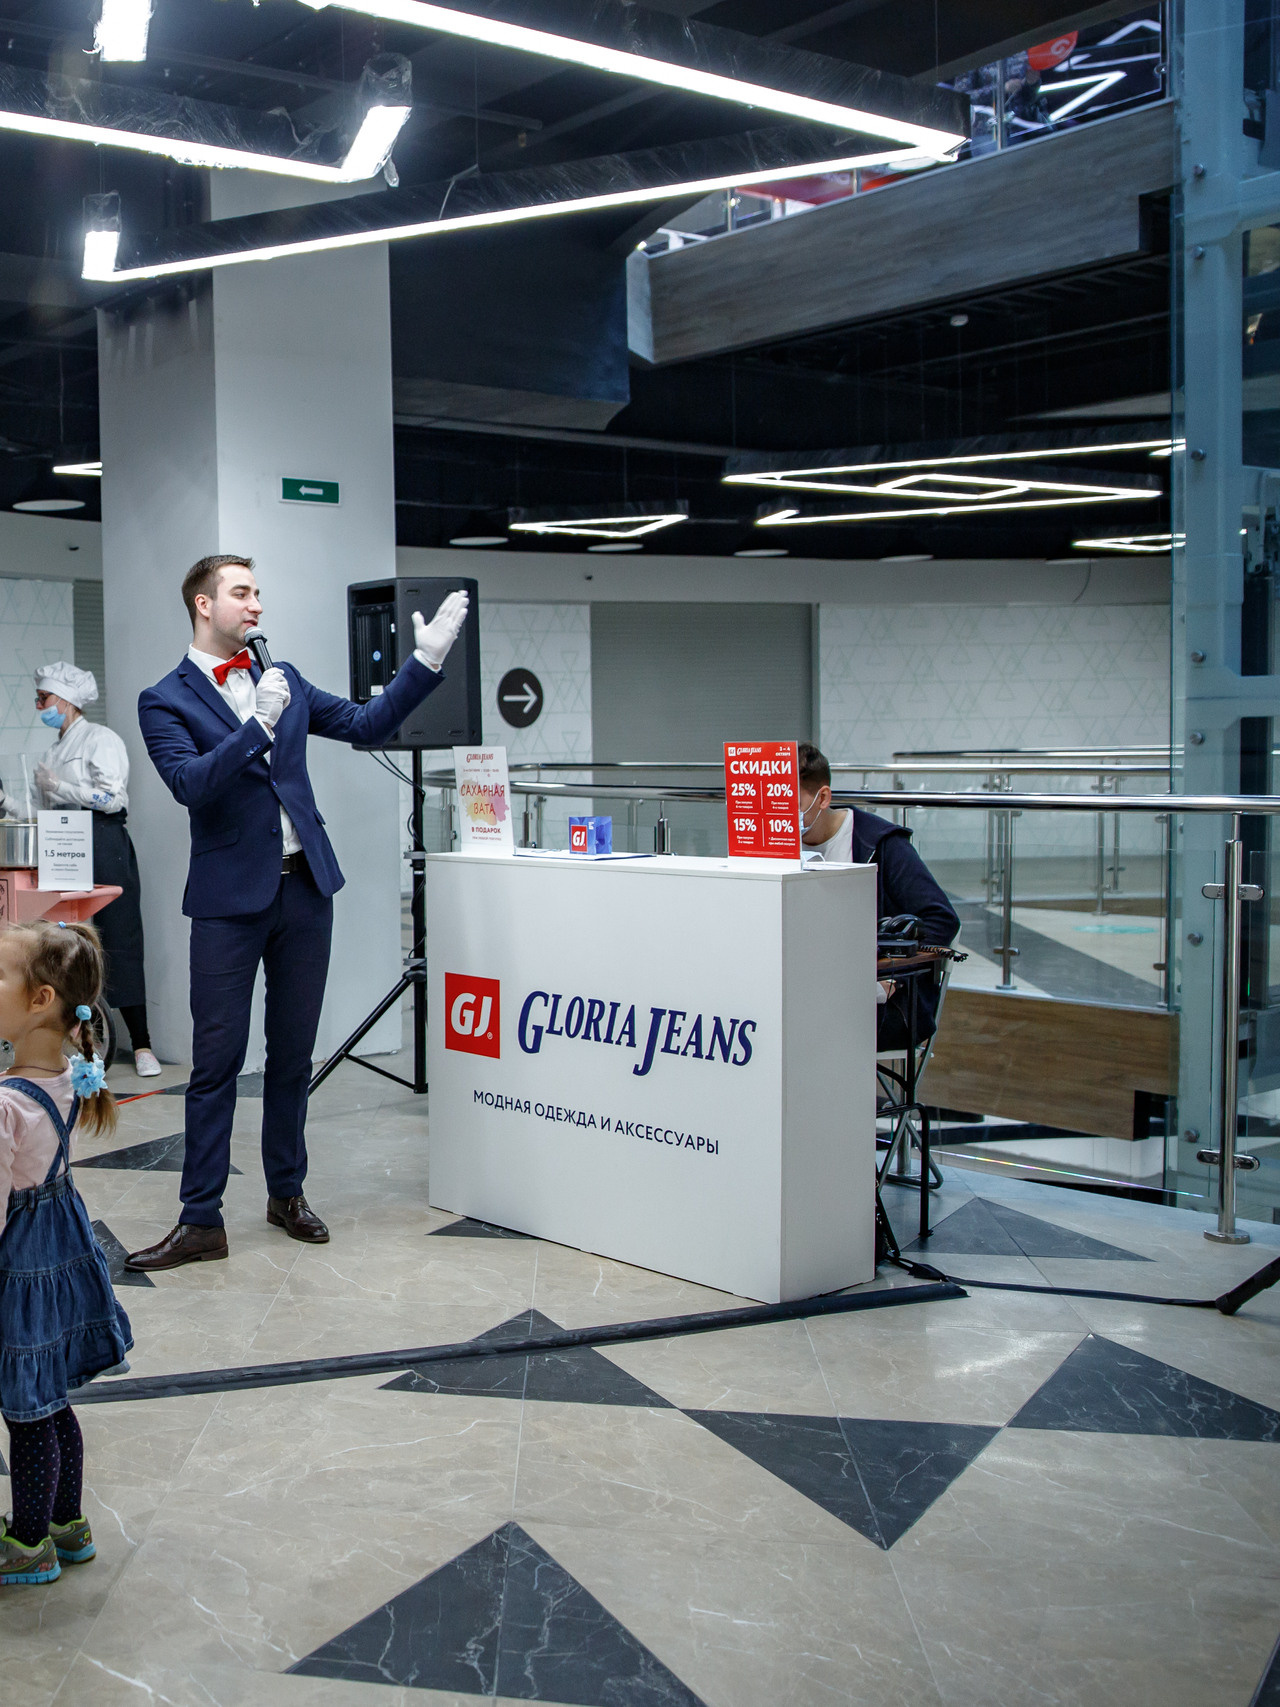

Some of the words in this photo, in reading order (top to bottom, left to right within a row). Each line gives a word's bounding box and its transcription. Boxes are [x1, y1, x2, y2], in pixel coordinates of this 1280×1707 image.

[730, 761, 792, 776] СКИДКИ
[460, 784, 505, 798] САХАРНАЯ
[731, 783, 757, 797] 25%
[766, 784, 794, 797] 20%
[473, 802, 496, 815] ВАТА
[733, 818, 757, 832] 15%
[768, 819, 794, 833] 10%
[57, 851, 86, 859] метров
[518, 990, 637, 1054] GLORIA
[632, 1007, 758, 1077] JEANS
[473, 1089, 531, 1115] МОДНАЯ
[534, 1102, 597, 1129] ОДЕЖДА
[600, 1115, 611, 1132] И
[614, 1119, 719, 1155] АКСЕССУАРЫ
